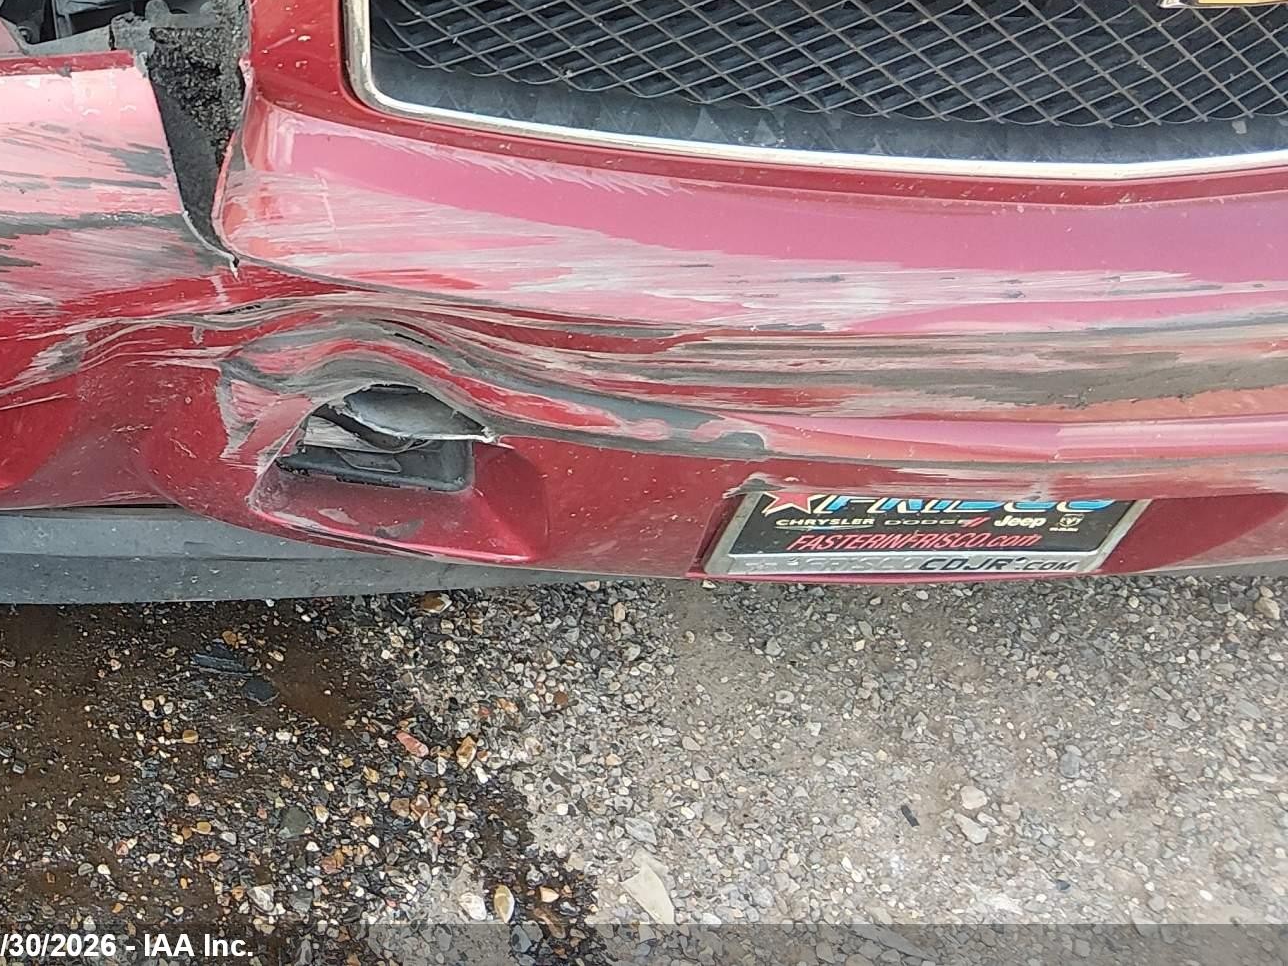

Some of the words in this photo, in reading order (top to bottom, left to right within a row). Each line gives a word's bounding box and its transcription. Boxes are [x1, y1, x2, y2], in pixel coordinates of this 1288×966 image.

[775, 518, 876, 526] CHRYSLER
[994, 515, 1047, 528] Jeep
[786, 533, 1043, 551] FASTERINFRISCO.com
